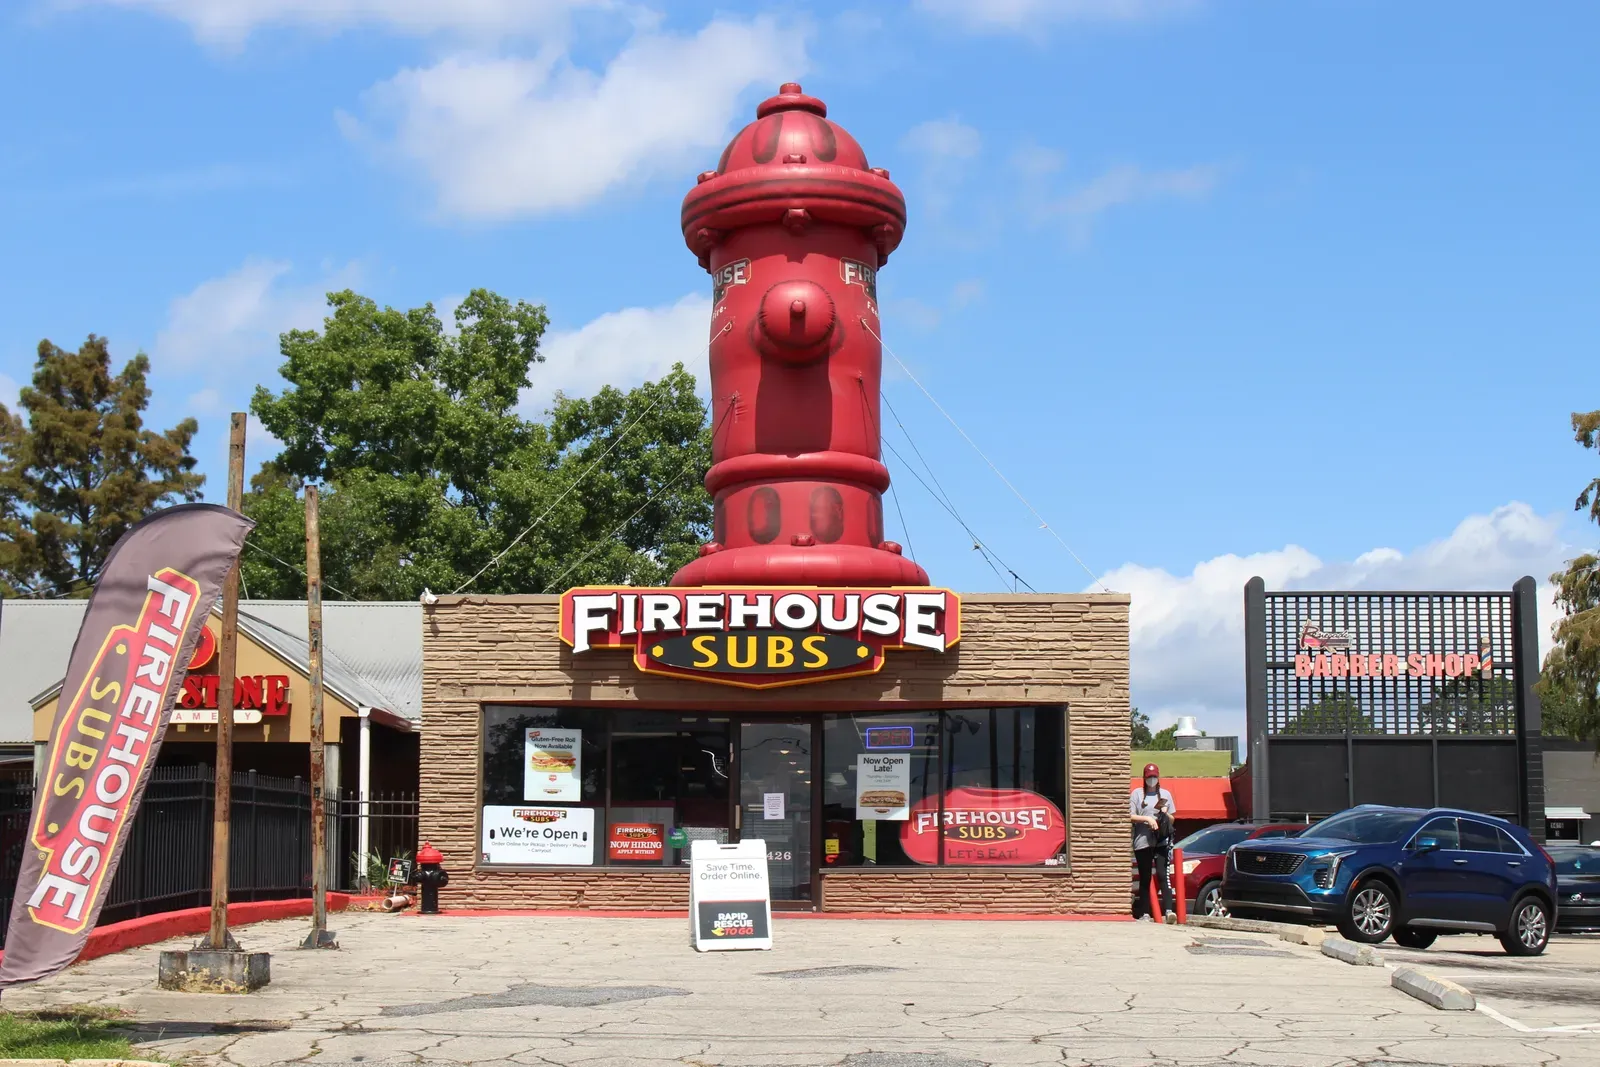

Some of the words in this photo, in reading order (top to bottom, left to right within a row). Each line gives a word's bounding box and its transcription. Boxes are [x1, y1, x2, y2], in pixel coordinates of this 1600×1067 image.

[713, 262, 747, 289] USE
[572, 592, 946, 653] FIREHOUSE
[691, 635, 830, 668] SUBS
[1295, 653, 1400, 677] BARBER
[1407, 653, 1480, 677] SHOP
[54, 676, 122, 799] SUBS
[868, 730, 912, 747] OPEN
[26, 574, 191, 922] FIREHOUSE
[863, 757, 881, 765] Now
[882, 757, 904, 765] Open
[514, 810, 566, 819] FIREHOUSE
[917, 809, 1048, 834] FIREHOUSE
[500, 827, 539, 838] We're
[543, 828, 578, 840] Open
[616, 828, 658, 836] FIREHOUSE
[959, 826, 1007, 839] SUBS
[631, 841, 662, 849] HIRING
[700, 872, 727, 880] Order
[714, 920, 753, 928] RESCUE
